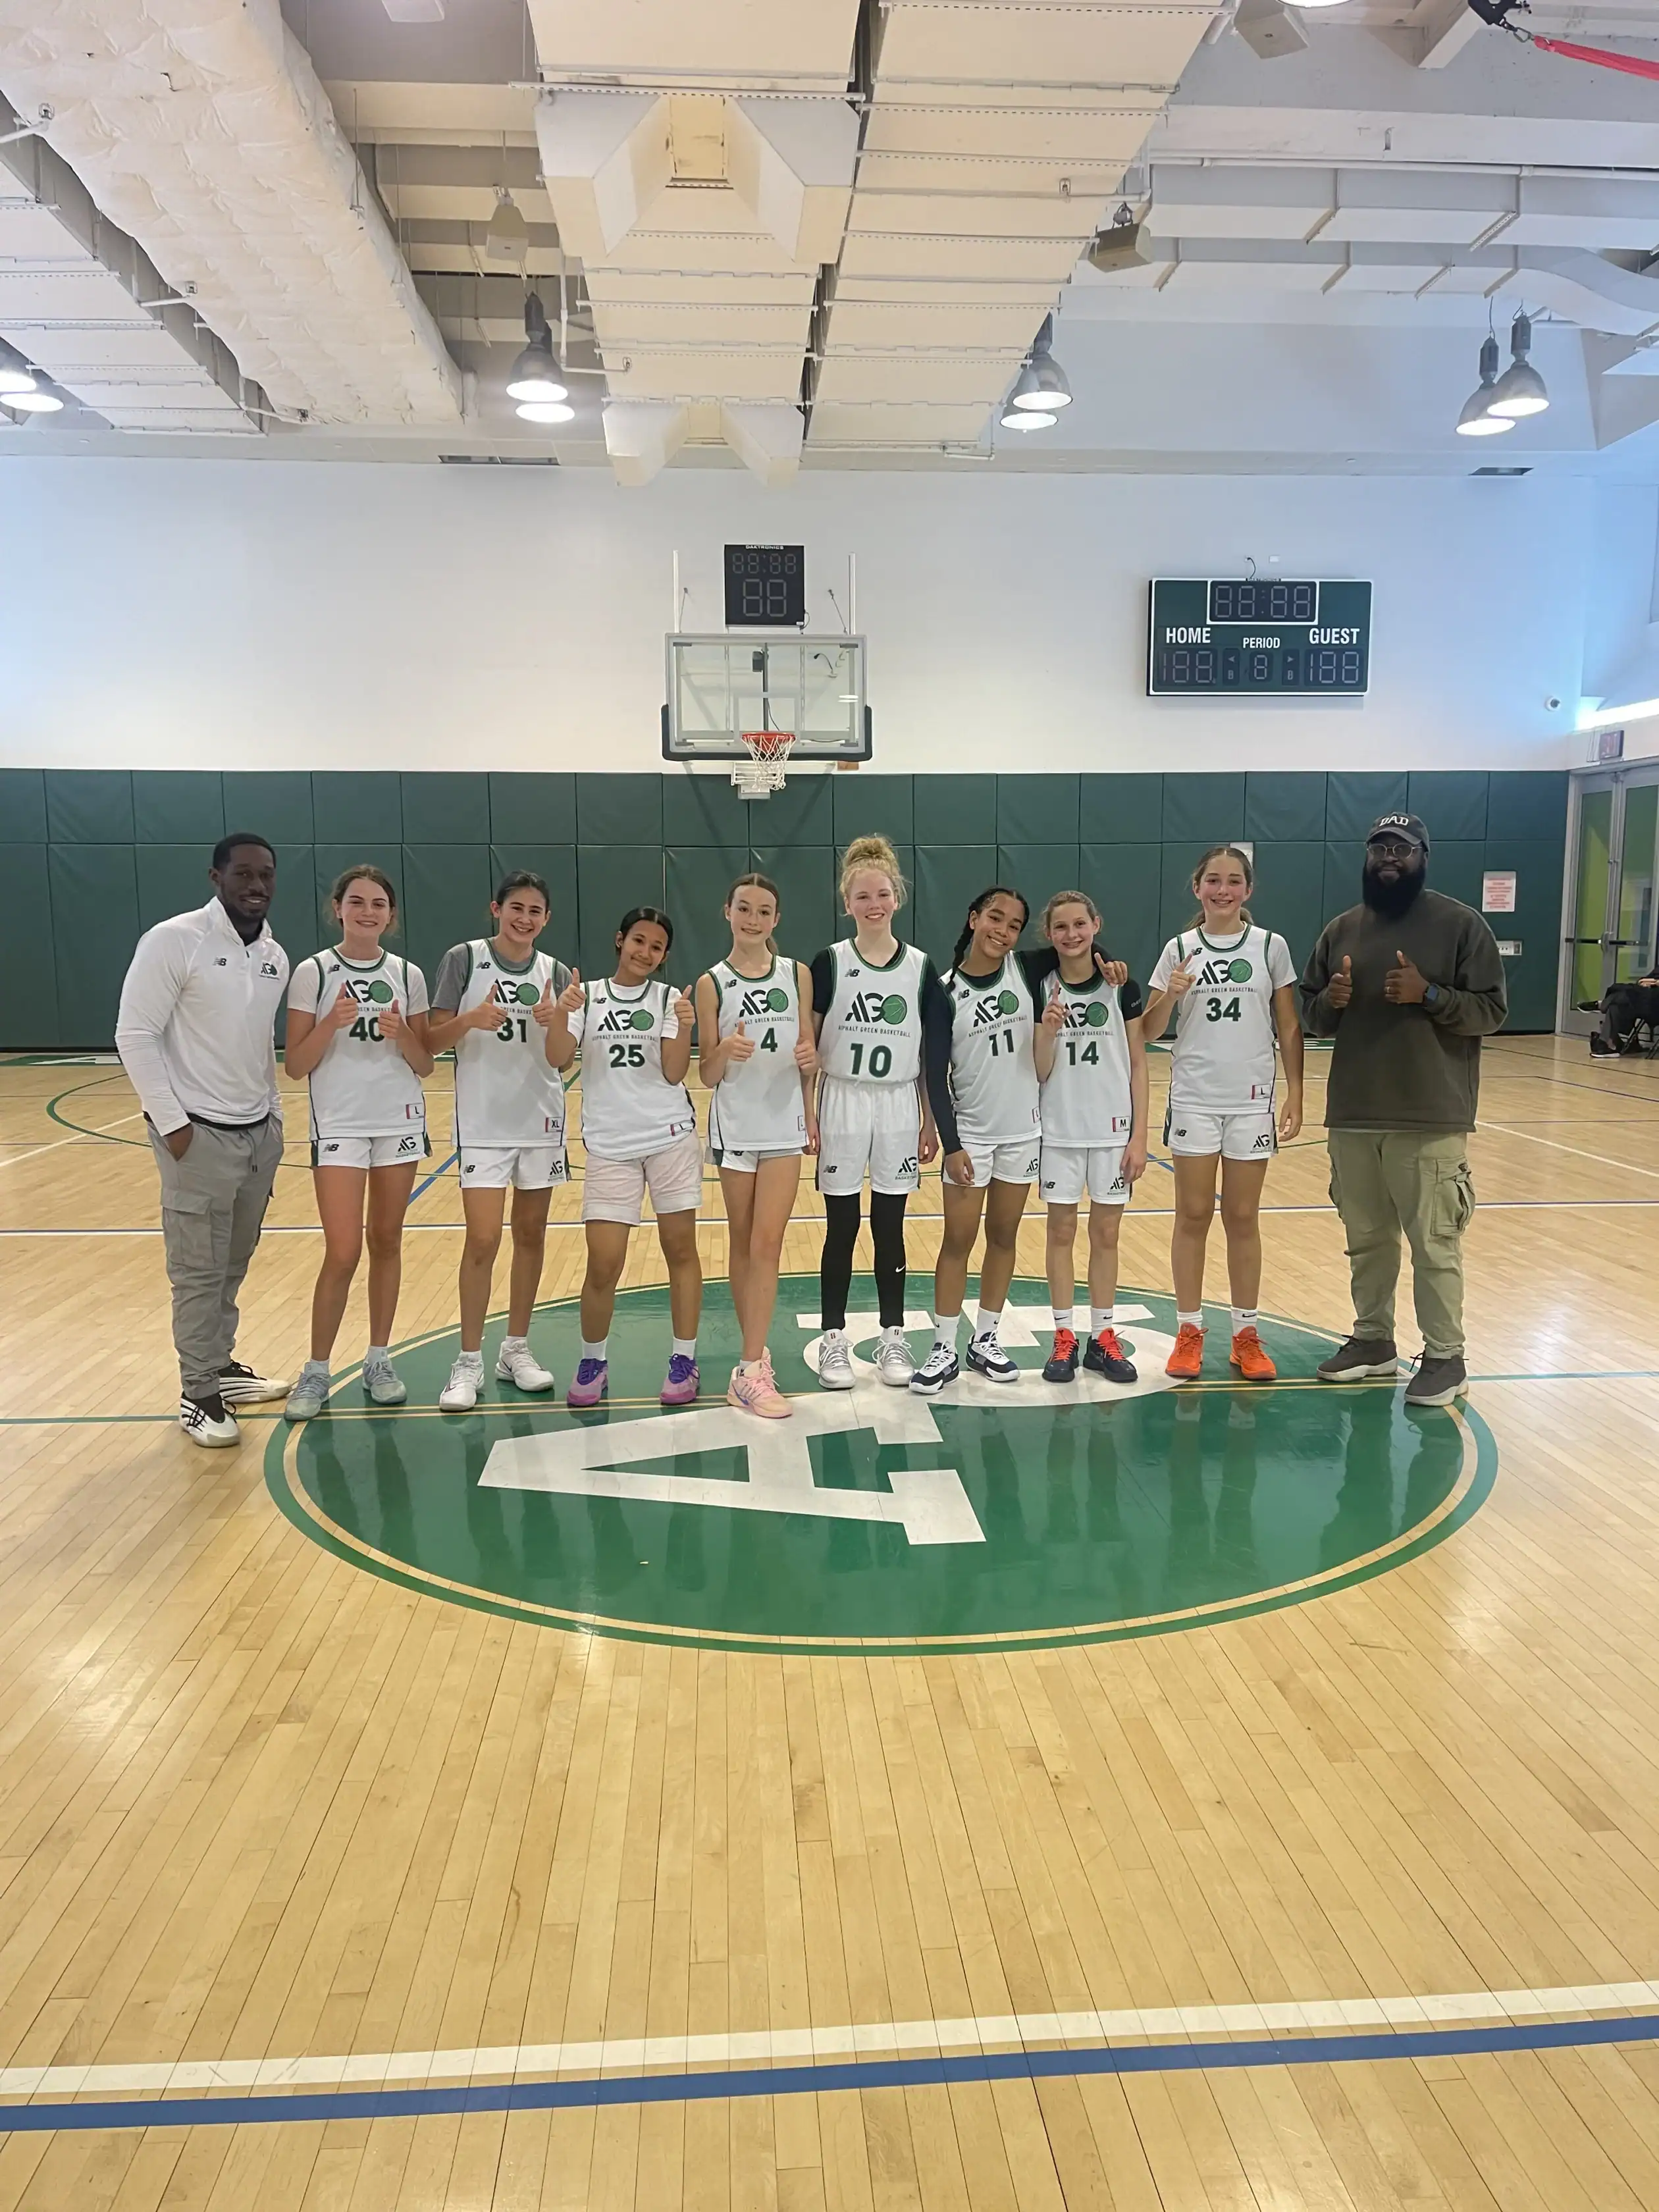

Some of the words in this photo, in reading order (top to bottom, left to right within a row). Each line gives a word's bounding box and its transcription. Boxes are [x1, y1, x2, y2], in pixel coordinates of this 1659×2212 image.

[1166, 627, 1211, 644] HOME
[1243, 637, 1280, 648] PERIOD
[1309, 627, 1360, 645] GUEST
[1379, 816, 1409, 827] DAD
[1206, 997, 1242, 1022] 34
[497, 1016, 527, 1043] 31
[760, 1028, 777, 1052] 4
[989, 1029, 1014, 1056] 11
[1066, 1041, 1099, 1066] 14
[609, 1044, 645, 1068] 25
[851, 1043, 892, 1078] 10
[1120, 1119, 1126, 1128] M
